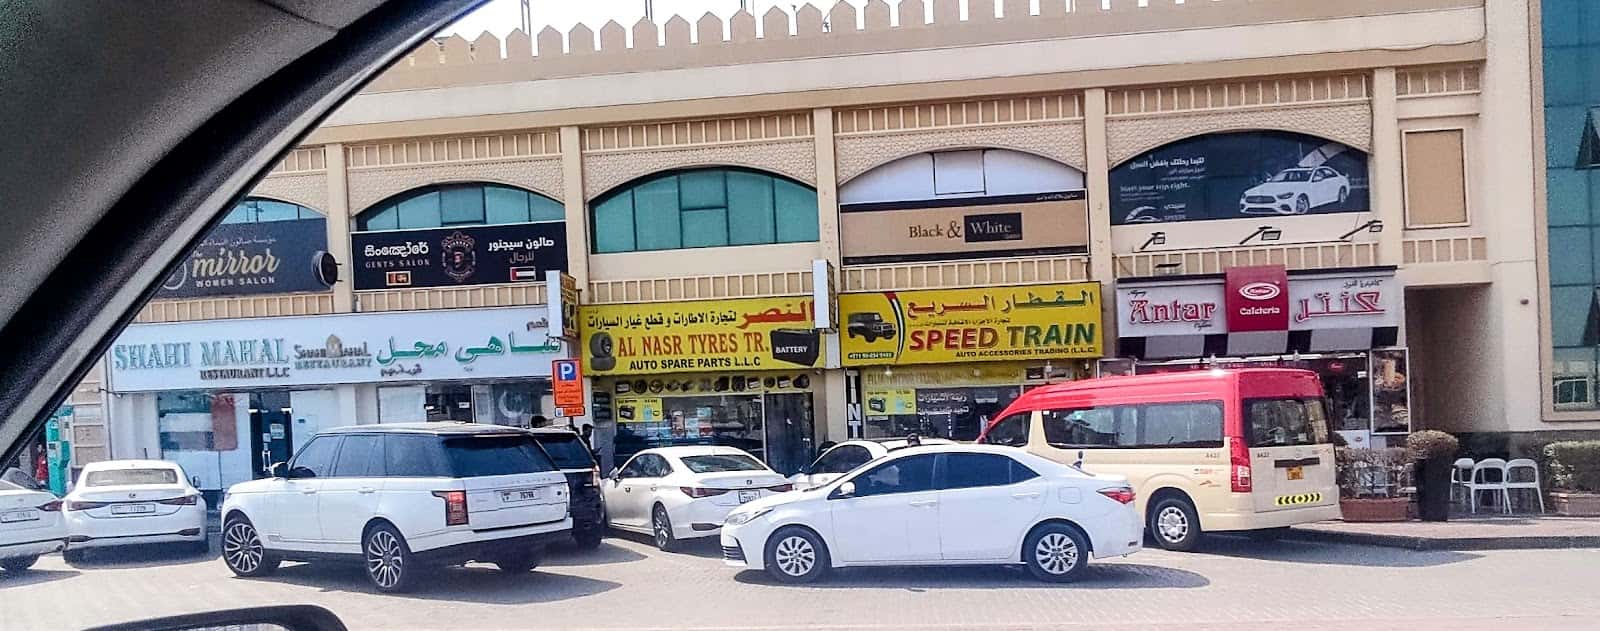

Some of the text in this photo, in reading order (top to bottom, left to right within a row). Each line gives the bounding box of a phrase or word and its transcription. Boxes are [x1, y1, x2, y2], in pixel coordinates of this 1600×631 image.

[909, 220, 1011, 239] Black & White
[526, 237, 554, 250] صالون
[192, 248, 280, 278] mirror
[365, 259, 430, 269] GENTS SALON
[196, 276, 275, 288] WOMEN SALON
[907, 289, 1094, 320] القطار السريع
[1129, 299, 1217, 325] Antar
[1240, 306, 1280, 316] Cafeteria
[588, 315, 622, 330] السيارات
[624, 313, 642, 329] غيار
[644, 312, 664, 330] قطع
[665, 317, 671, 328] و
[711, 310, 737, 326] لتجارة
[736, 300, 815, 329] النصر
[618, 332, 770, 357] AL NASR TYRES TR.
[909, 322, 1096, 353] SPEED TRAIN
[115, 338, 288, 370] SHAHI MAHAL
[775, 346, 808, 354] BATTERY
[979, 348, 1032, 357] ACCESSORIES
[1034, 347, 1069, 355] TRADING
[561, 363, 573, 380] P
[630, 360, 658, 370] AUTO
[661, 358, 694, 369] SPARE
[697, 357, 731, 368] PARTS
[200, 368, 264, 380] RESTAURANT
